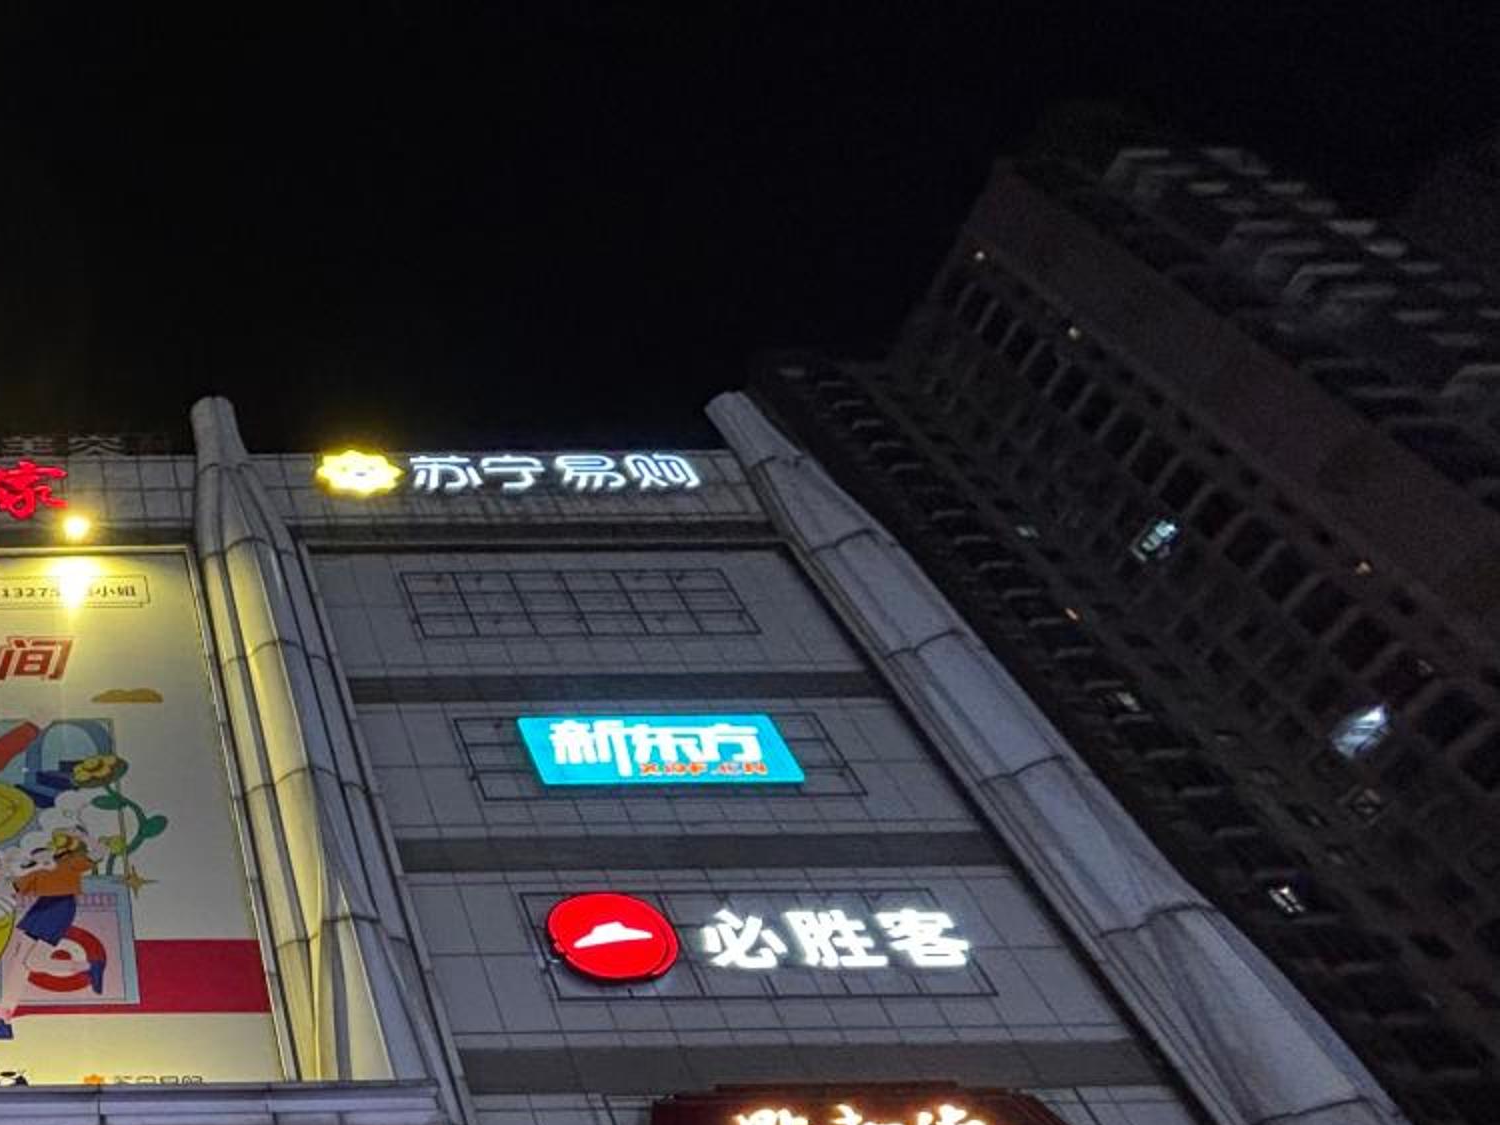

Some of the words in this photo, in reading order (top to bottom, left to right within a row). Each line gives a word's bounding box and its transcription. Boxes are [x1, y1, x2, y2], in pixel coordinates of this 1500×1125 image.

[411, 454, 701, 491] 苏宁易购
[550, 720, 762, 776] 新东方
[702, 908, 970, 969] 必胜客
